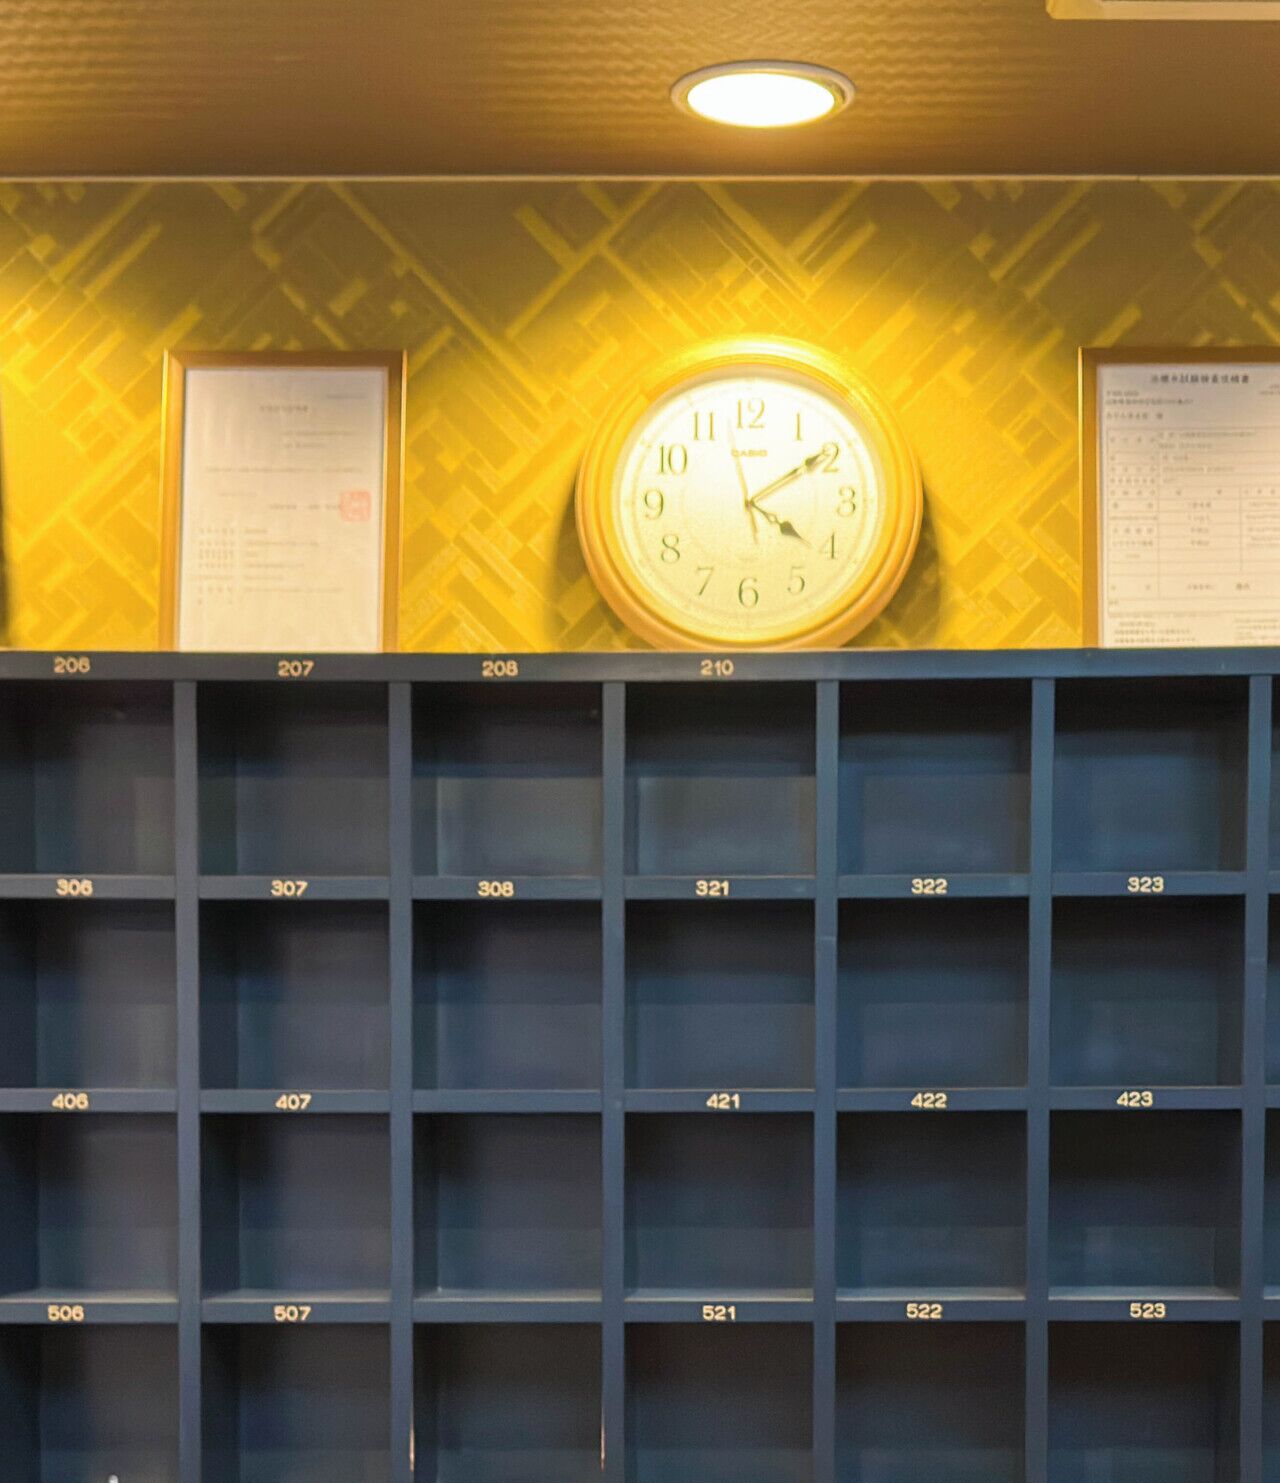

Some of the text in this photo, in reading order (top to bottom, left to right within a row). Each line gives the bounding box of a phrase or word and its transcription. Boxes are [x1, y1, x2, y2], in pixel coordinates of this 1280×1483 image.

[736, 398, 766, 429] 12
[693, 412, 716, 441] 11
[795, 413, 803, 441] 1
[657, 445, 688, 475] 10
[822, 442, 840, 473] 2
[644, 488, 664, 520] 9
[837, 486, 857, 517] 3
[661, 534, 681, 564] 8
[822, 532, 839, 560] 4
[697, 567, 714, 596] 7
[787, 566, 805, 595] 5
[738, 577, 759, 608] 6
[53, 655, 91, 676] 206
[277, 659, 315, 678] 207
[481, 659, 519, 679] 208
[700, 658, 735, 677] 210
[56, 876, 94, 897] 306
[271, 879, 309, 897] 307
[478, 880, 515, 898] 308
[694, 878, 730, 897] 321
[910, 878, 947, 895] 322
[1128, 876, 1163, 893] 323
[51, 1088, 90, 1111] 406
[275, 1092, 311, 1111] 407
[705, 1091, 740, 1109] 421
[909, 1092, 948, 1109] 422
[1115, 1090, 1153, 1108] 423
[47, 1303, 85, 1323] 506
[273, 1305, 312, 1322] 507
[703, 1305, 737, 1322] 521
[906, 1302, 943, 1320] 522
[1130, 1302, 1166, 1319] 523
